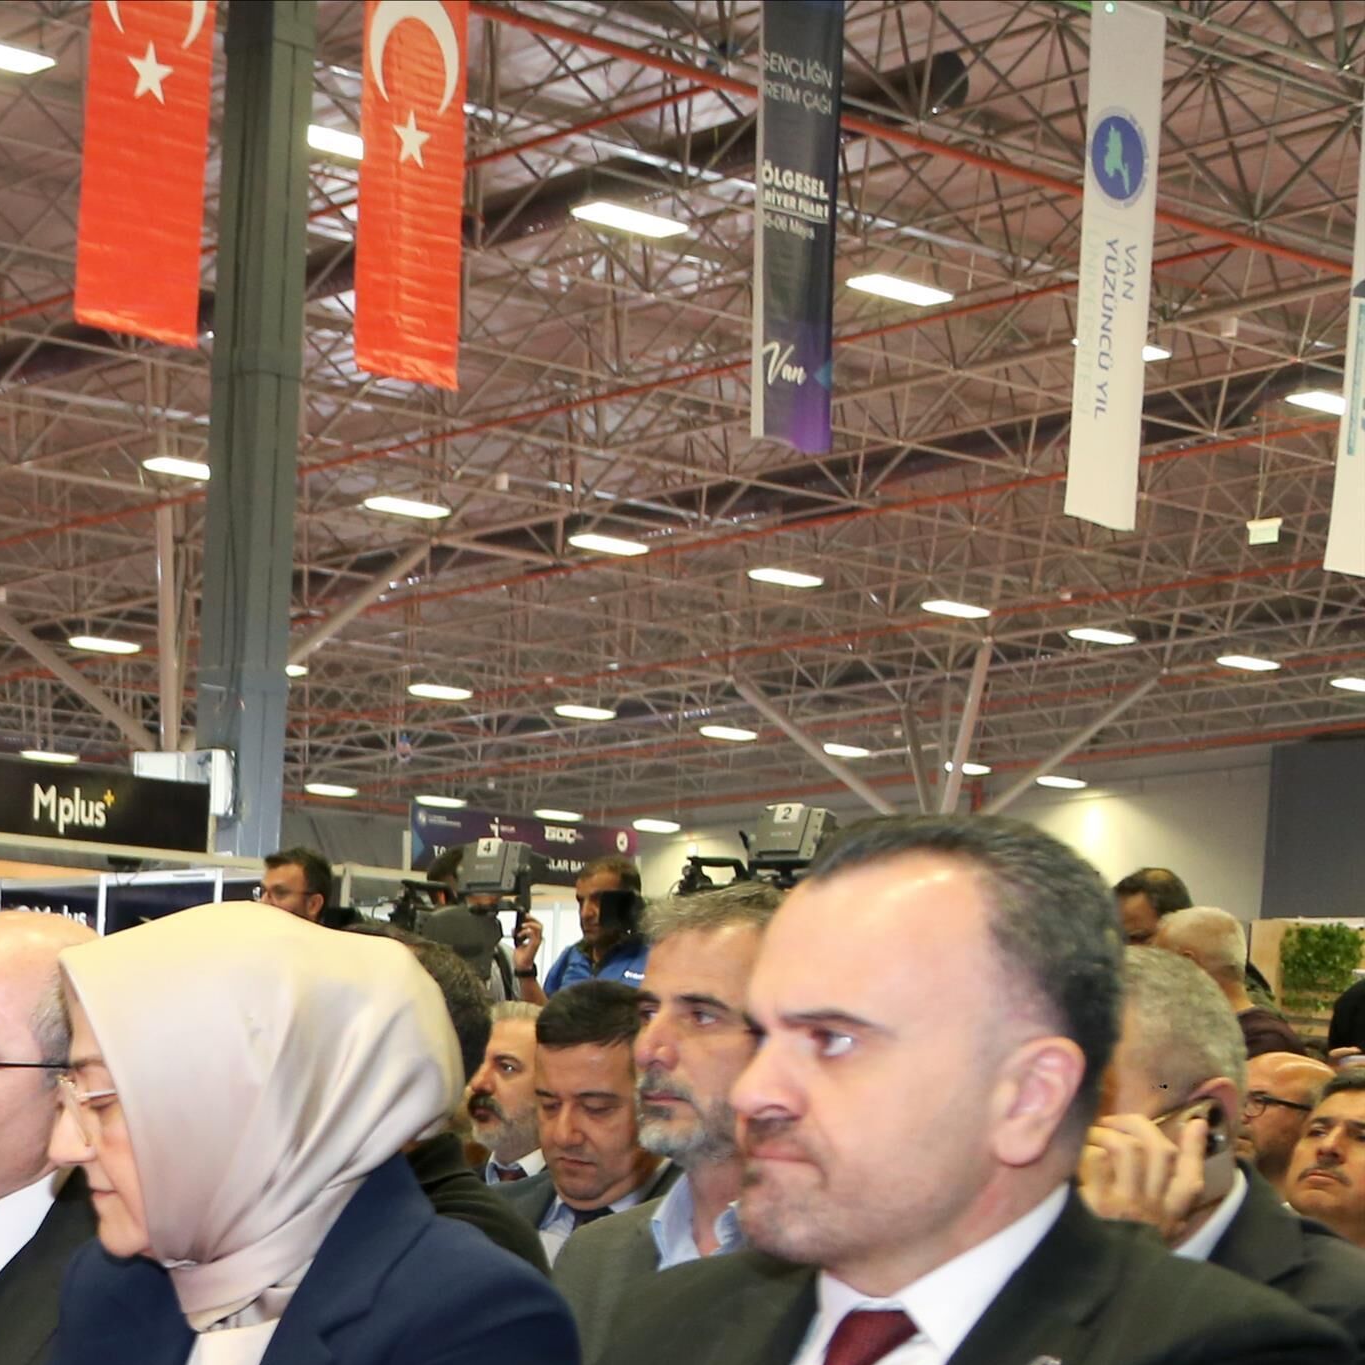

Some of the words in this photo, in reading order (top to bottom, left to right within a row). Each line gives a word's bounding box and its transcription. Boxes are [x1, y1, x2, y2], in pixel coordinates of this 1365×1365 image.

[764, 79, 800, 104] RETİM
[762, 159, 830, 200] ÖLGESEL
[1122, 244, 1138, 301] VAN
[1097, 238, 1121, 371] YÜZÜNCÜ
[762, 341, 807, 386] Van
[1094, 381, 1110, 420] YIL
[781, 807, 792, 820] 2
[483, 841, 492, 854] 4
